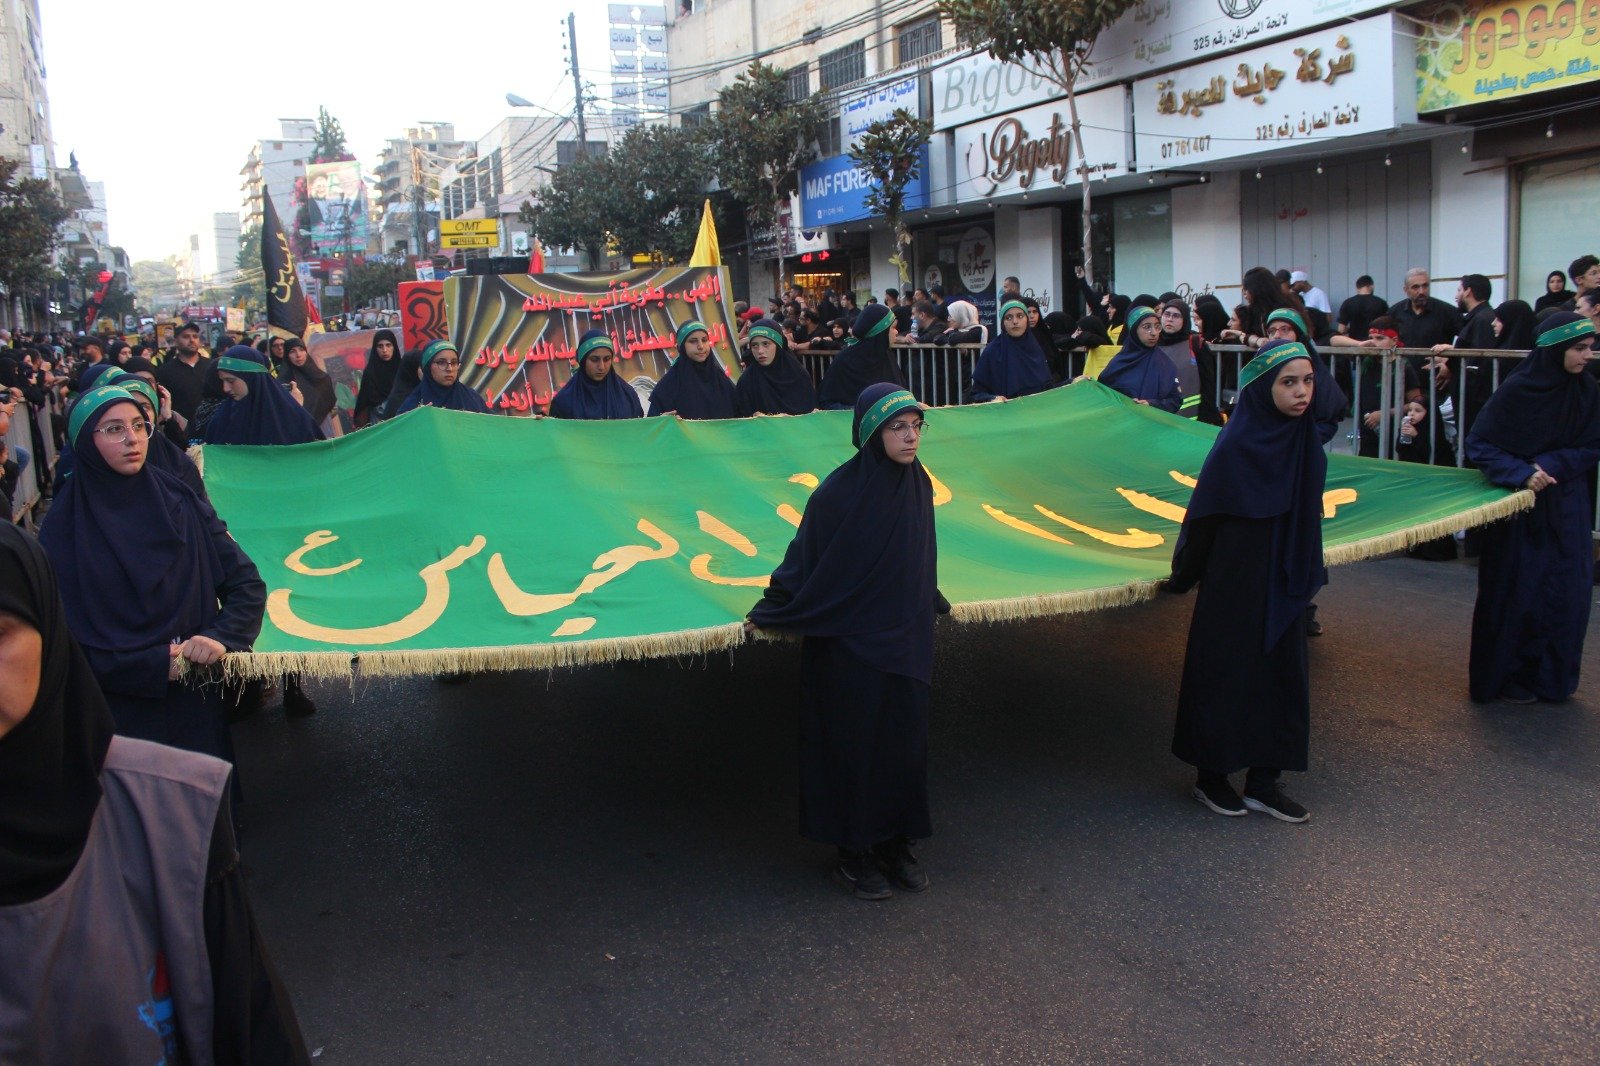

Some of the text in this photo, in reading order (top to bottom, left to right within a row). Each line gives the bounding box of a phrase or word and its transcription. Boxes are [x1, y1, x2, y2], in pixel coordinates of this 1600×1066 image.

[1193, 35, 1210, 51] 325
[1212, 30, 1227, 48] رقم
[1293, 34, 1356, 86] شركة
[1474, 73, 1518, 96] بطحينة
[1521, 67, 1556, 89] حمص
[1256, 124, 1274, 140] 325
[1278, 114, 1295, 140] رقم
[990, 112, 1072, 188] Bigoty
[1161, 142, 1173, 159] 07
[806, 174, 831, 201] MAF
[455, 221, 482, 232] OMT
[620, 281, 665, 310] بغربة
[502, 343, 520, 370] يا
